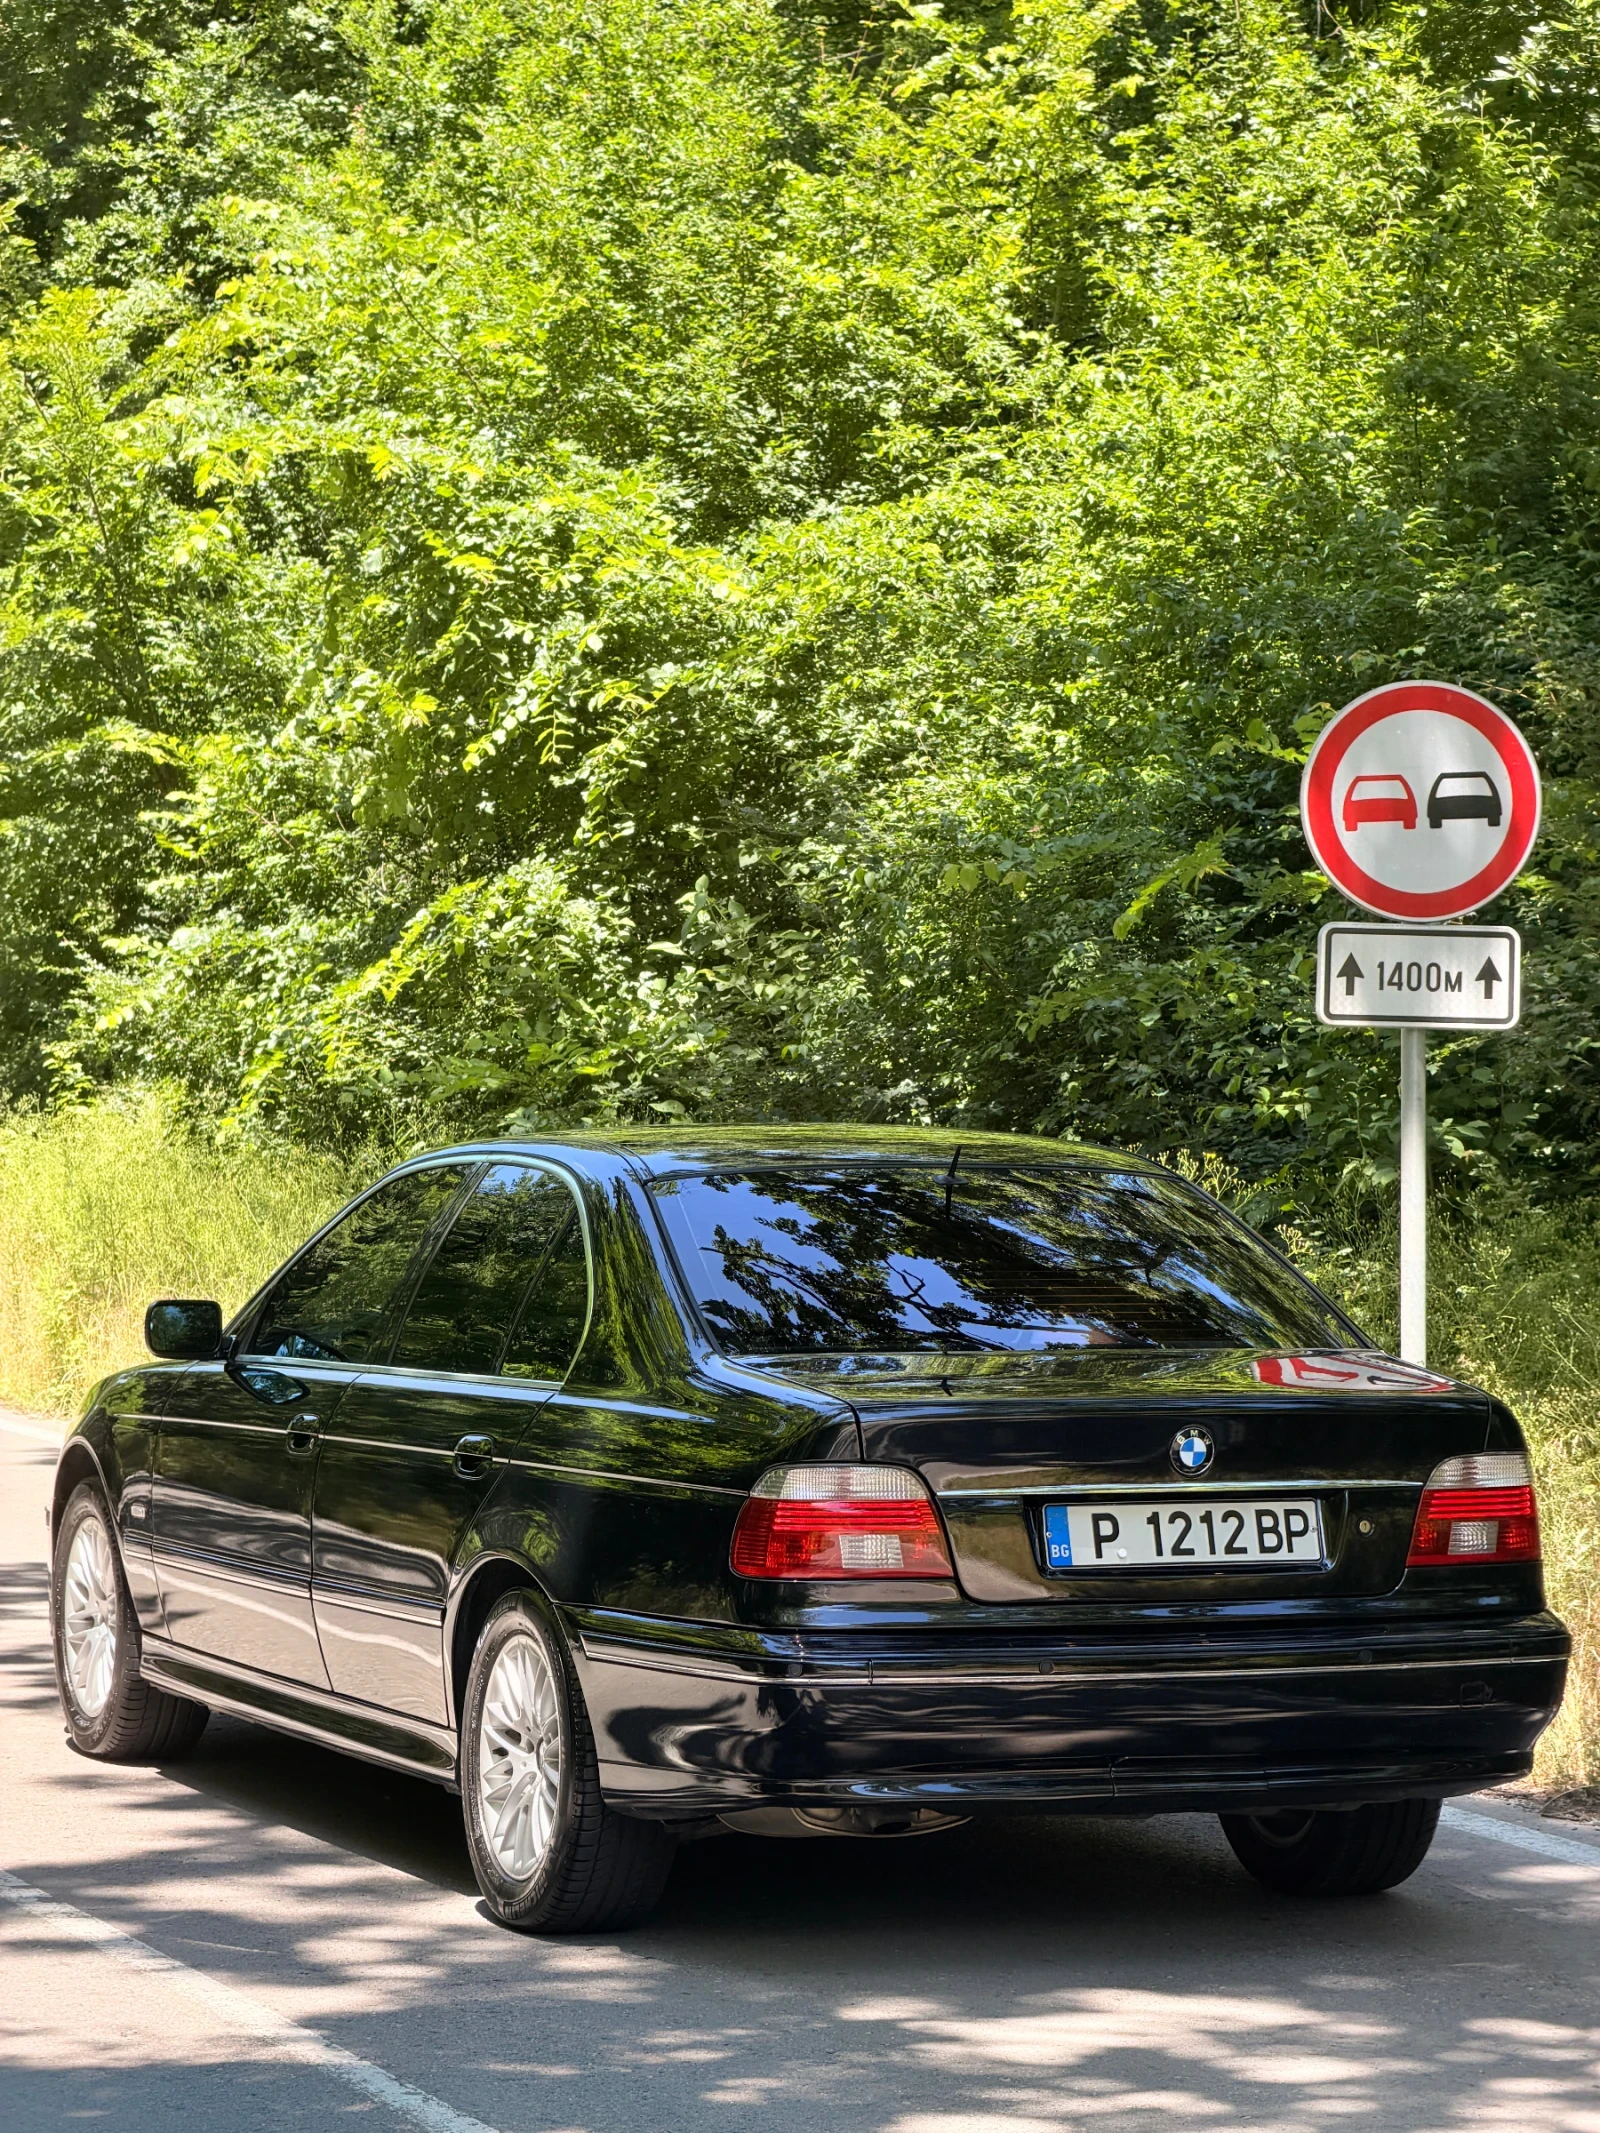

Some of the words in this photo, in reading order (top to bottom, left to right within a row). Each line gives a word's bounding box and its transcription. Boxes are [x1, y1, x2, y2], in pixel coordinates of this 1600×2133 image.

[1176, 1429, 1212, 1445] BMW
[1091, 1512, 1120, 1559] P
[1051, 1544, 1070, 1558] BG
